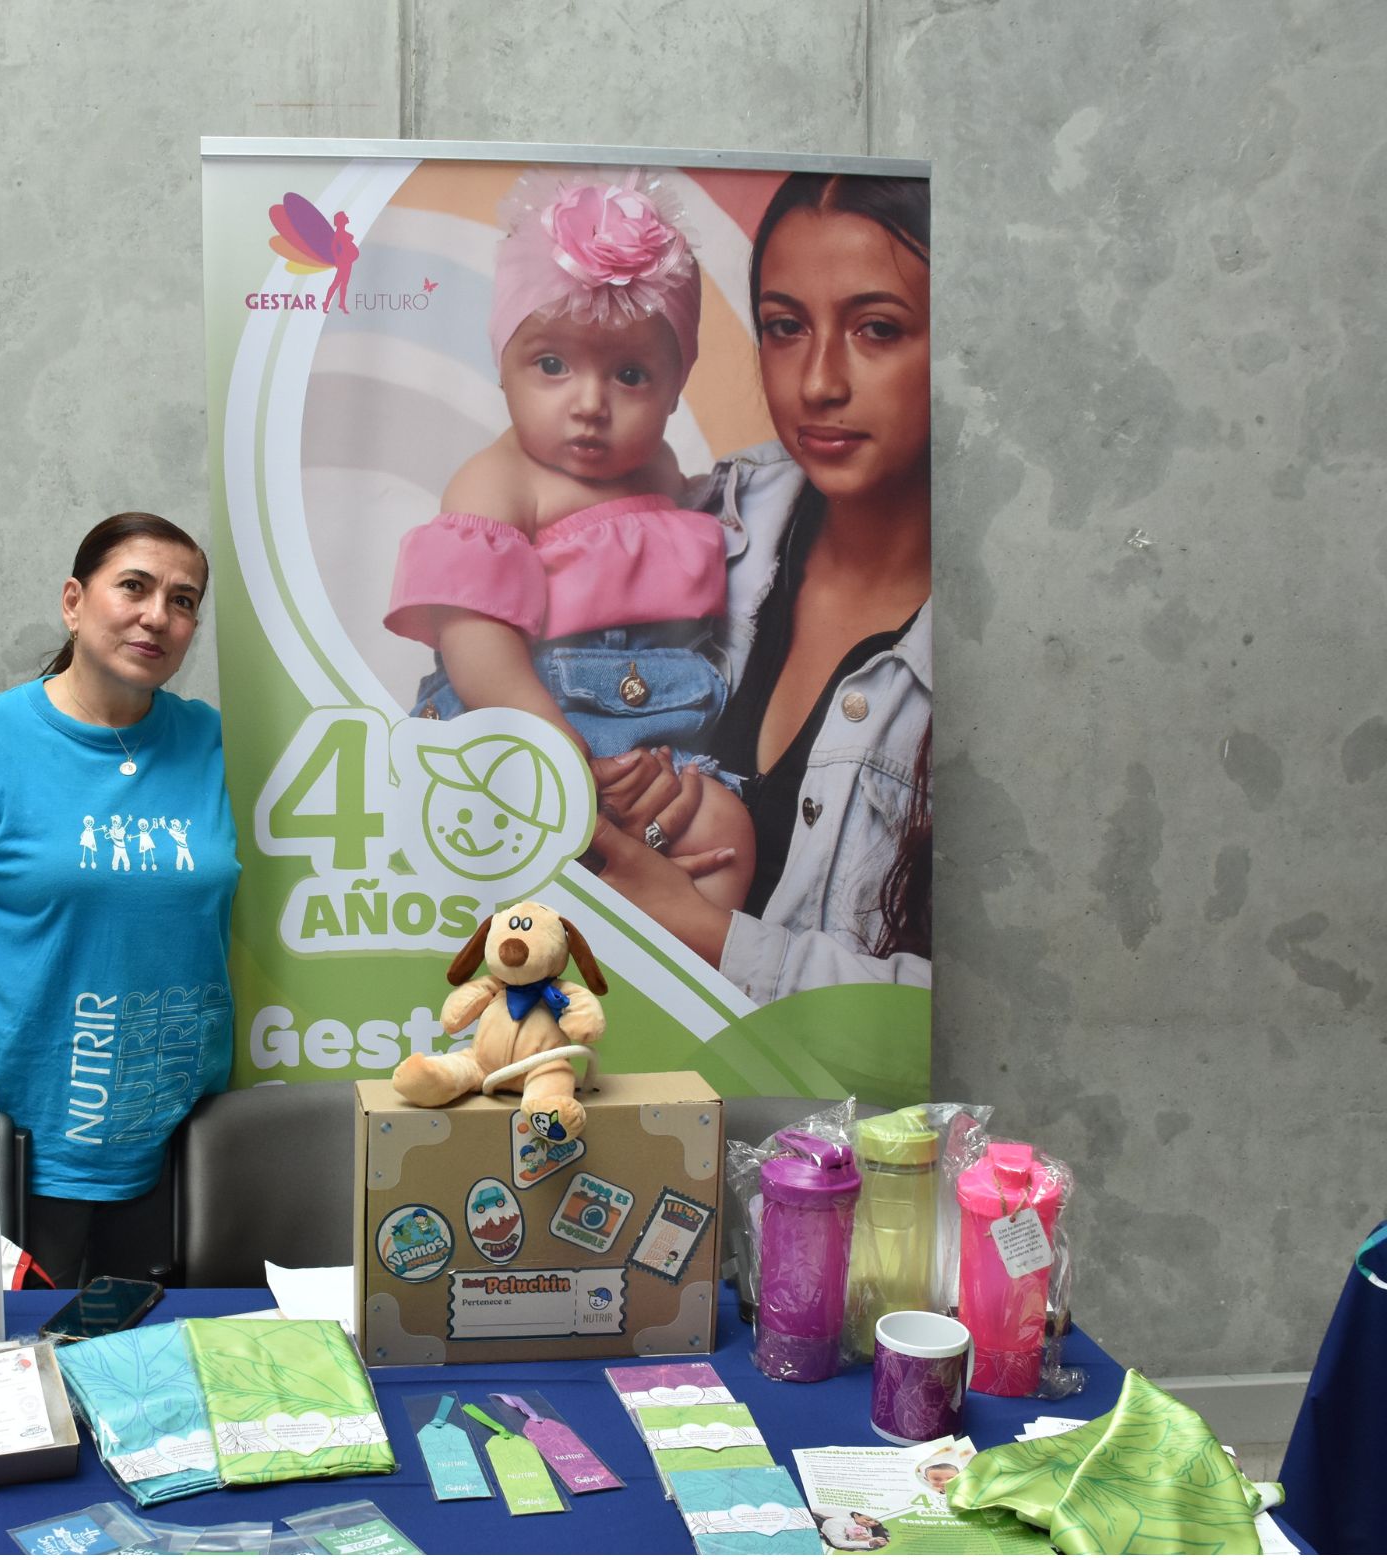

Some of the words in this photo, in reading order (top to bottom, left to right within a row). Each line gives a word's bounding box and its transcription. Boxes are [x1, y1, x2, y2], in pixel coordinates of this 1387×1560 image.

[245, 293, 317, 311] GESTAR
[355, 293, 430, 311] FUTURO
[300, 878, 479, 941] AÑOS
[65, 992, 118, 1145] NUTRIR
[579, 1176, 613, 1198] TODO
[388, 1236, 446, 1268] Vamos
[485, 1274, 572, 1296] Peluchin
[462, 1298, 502, 1307] Pertenece
[583, 1312, 614, 1325] NUTRIR
